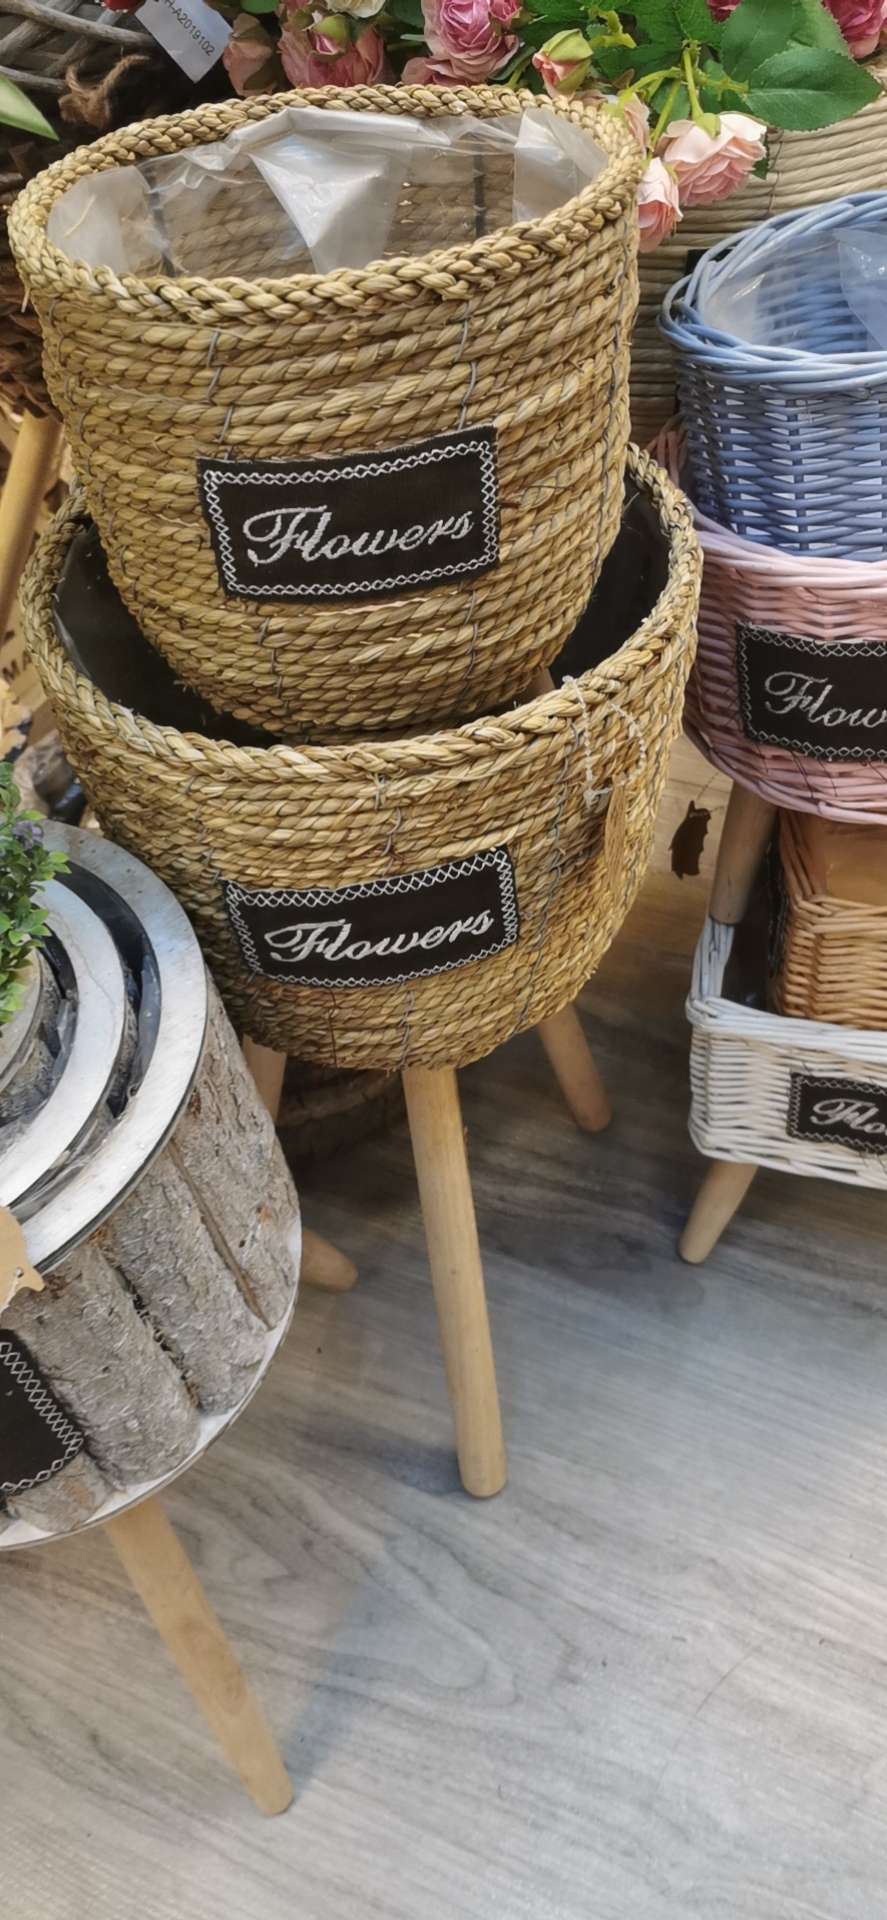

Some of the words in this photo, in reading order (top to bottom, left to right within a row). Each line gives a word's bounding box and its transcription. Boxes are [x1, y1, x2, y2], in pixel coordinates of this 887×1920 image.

[243, 505, 474, 567] Flowers
[264, 909, 494, 962] Flowers
[810, 1098, 887, 1136] Flo
